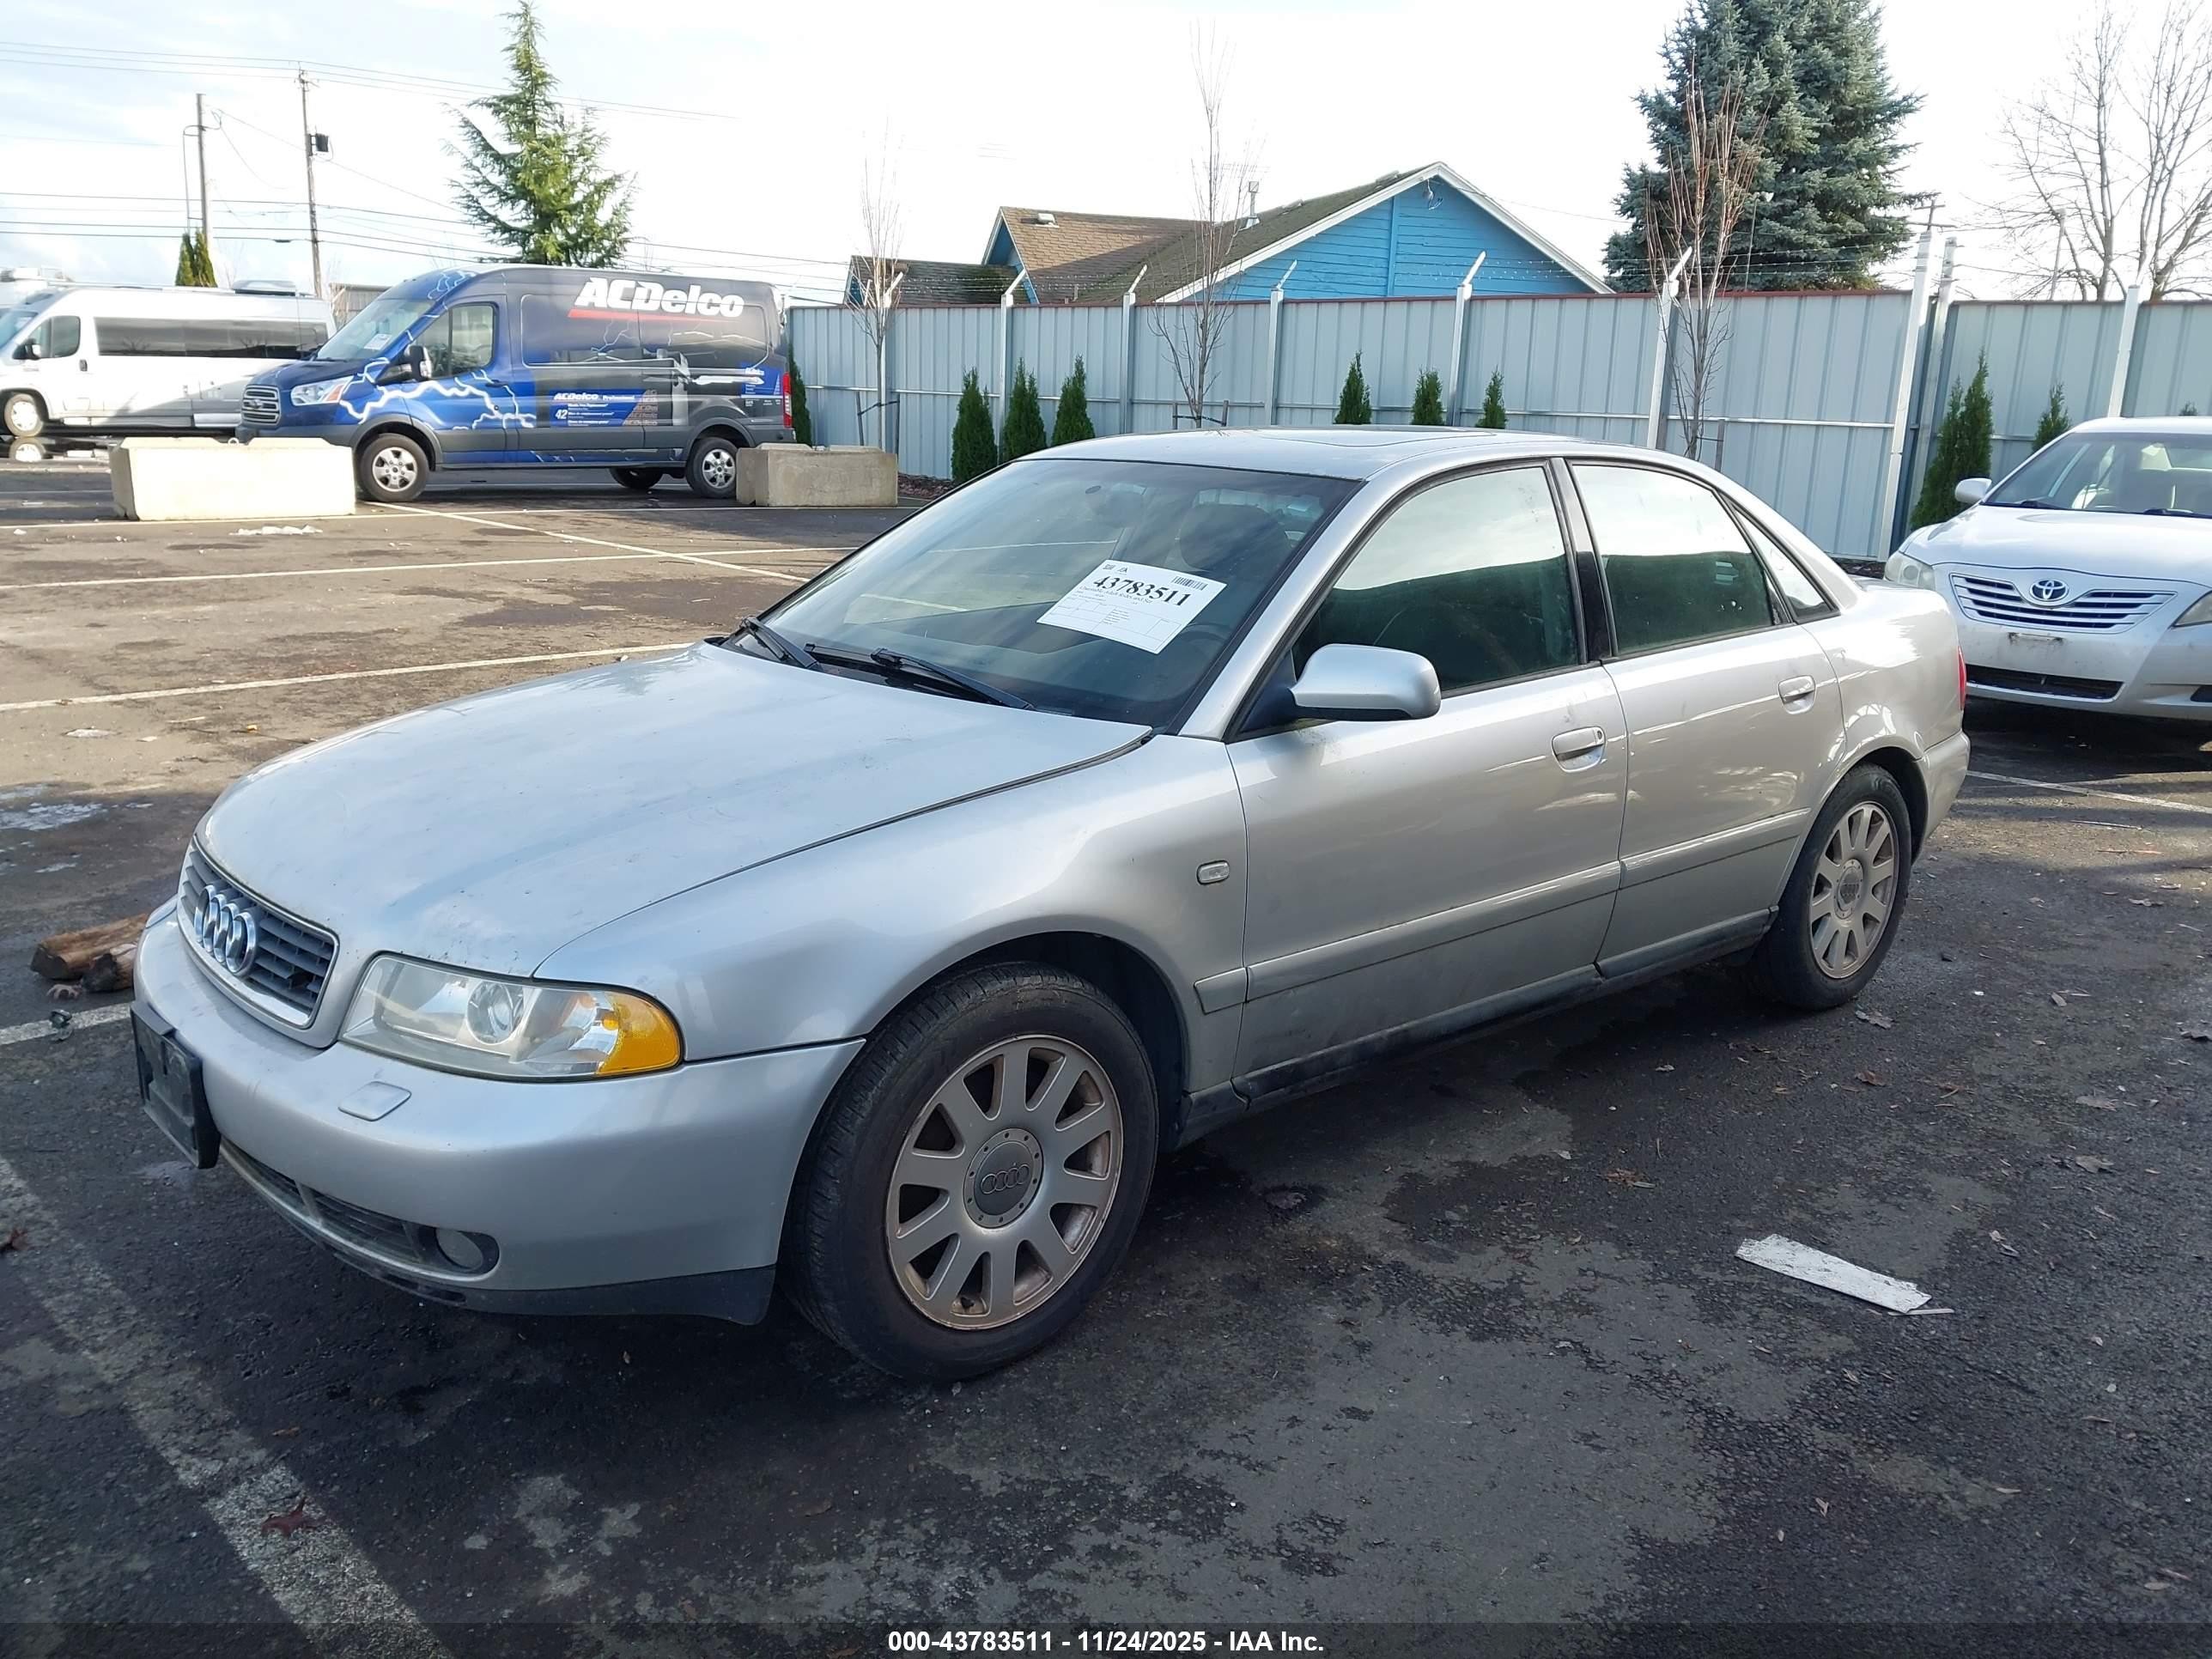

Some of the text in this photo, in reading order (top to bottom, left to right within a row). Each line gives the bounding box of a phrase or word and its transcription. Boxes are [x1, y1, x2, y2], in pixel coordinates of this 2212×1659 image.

[574, 276, 744, 318] ACDelco
[555, 409, 568, 420] 42
[1093, 575, 1191, 606] 43783511
